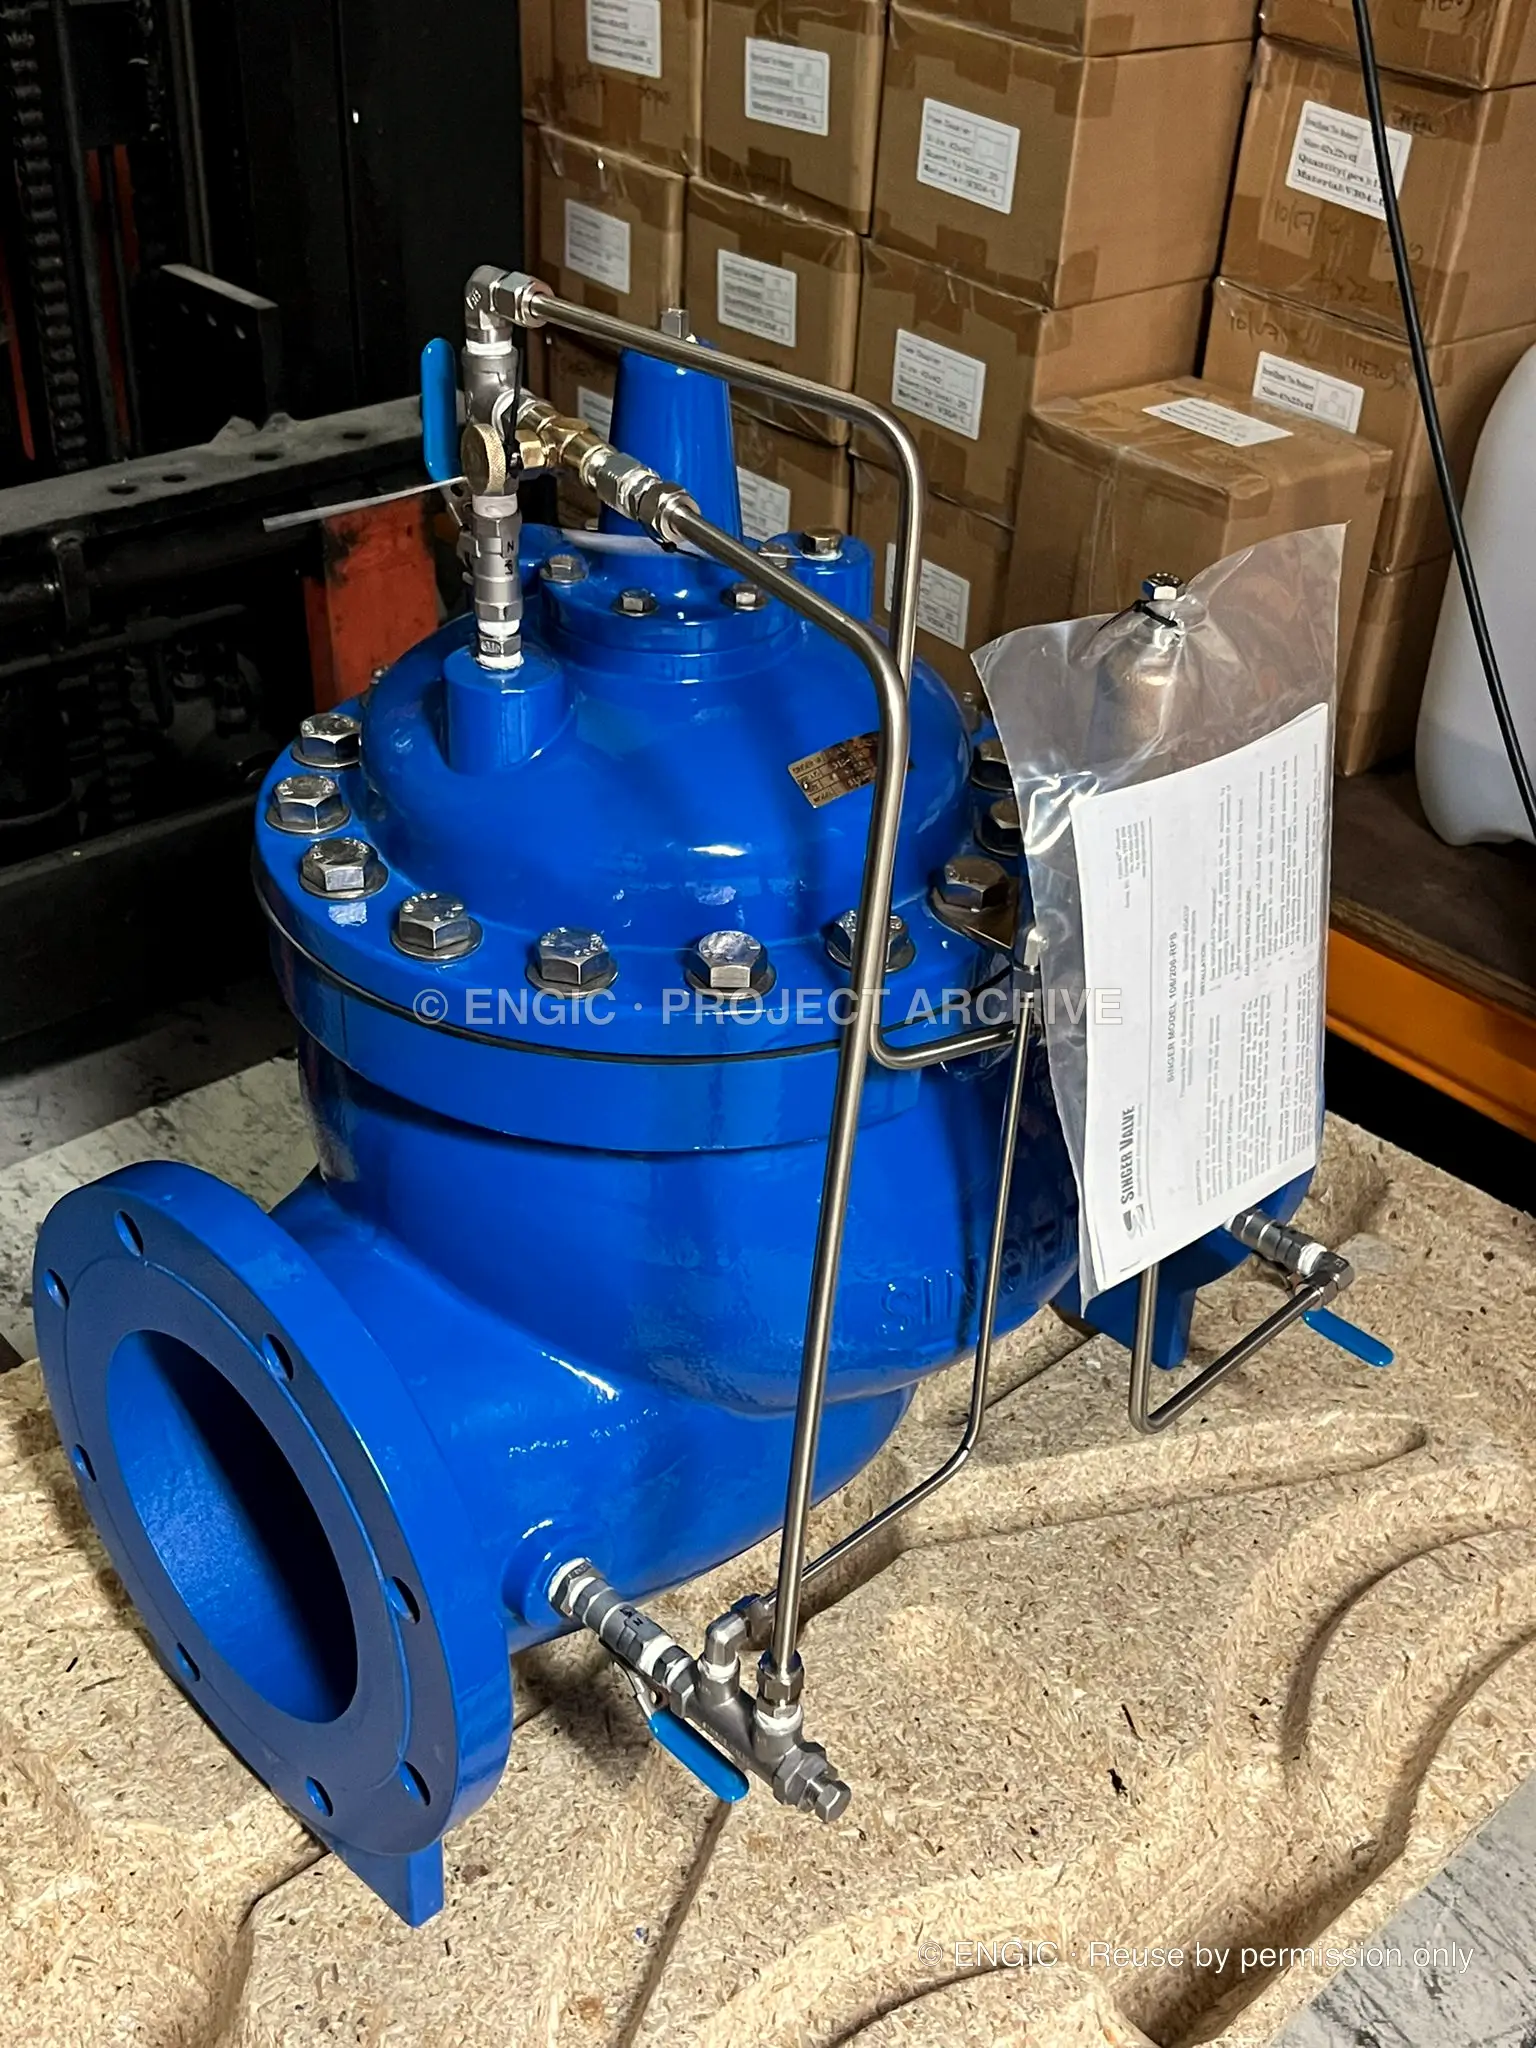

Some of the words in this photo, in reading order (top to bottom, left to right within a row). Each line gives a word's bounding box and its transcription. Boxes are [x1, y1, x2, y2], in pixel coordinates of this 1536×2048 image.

[1167, 1001, 1177, 1040] MODEL
[1166, 1042, 1176, 1083] SINGER
[1119, 1104, 1136, 1152] VALVE
[1120, 1149, 1135, 1206] SINGER
